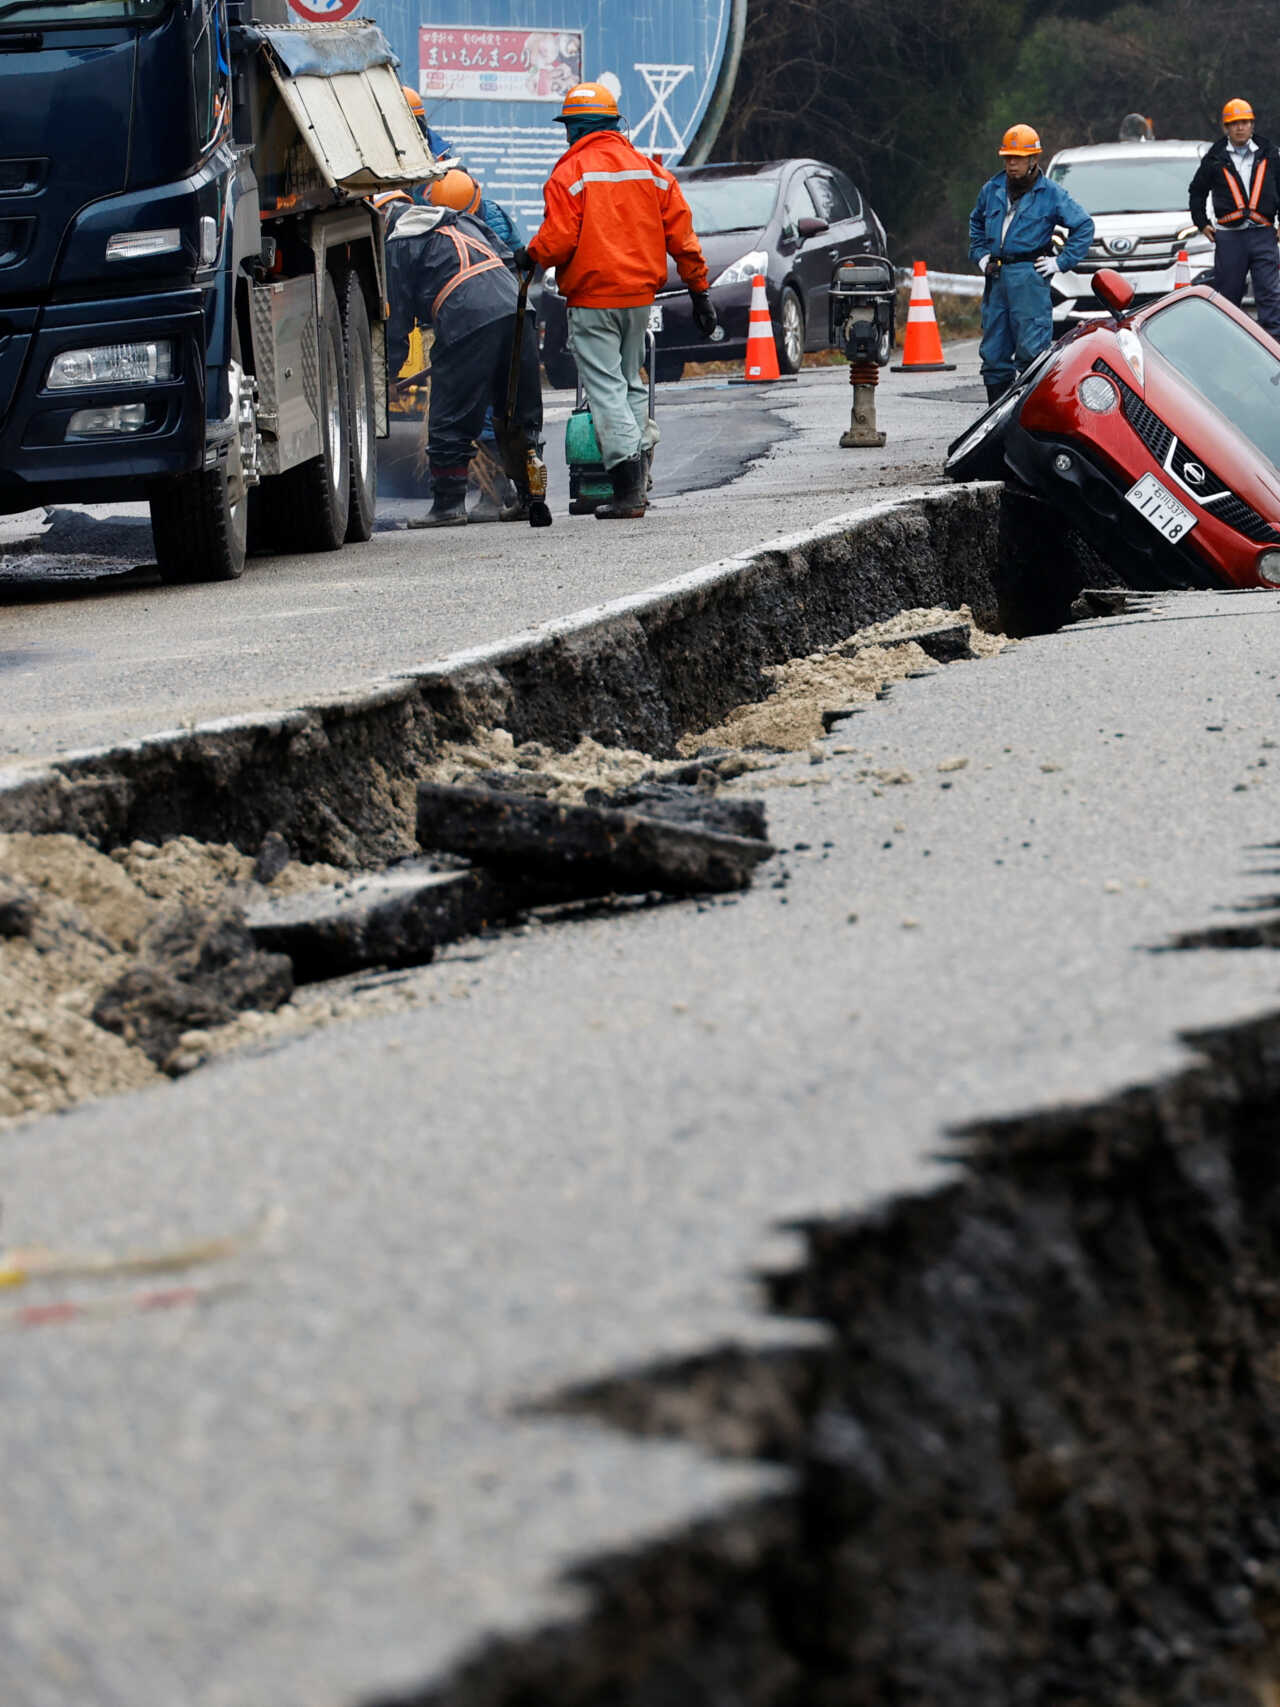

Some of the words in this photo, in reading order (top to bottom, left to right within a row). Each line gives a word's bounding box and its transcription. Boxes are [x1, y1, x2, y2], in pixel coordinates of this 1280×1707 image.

[428, 47, 531, 69] まいもんまつり
[1140, 496, 1183, 539] 11-18
